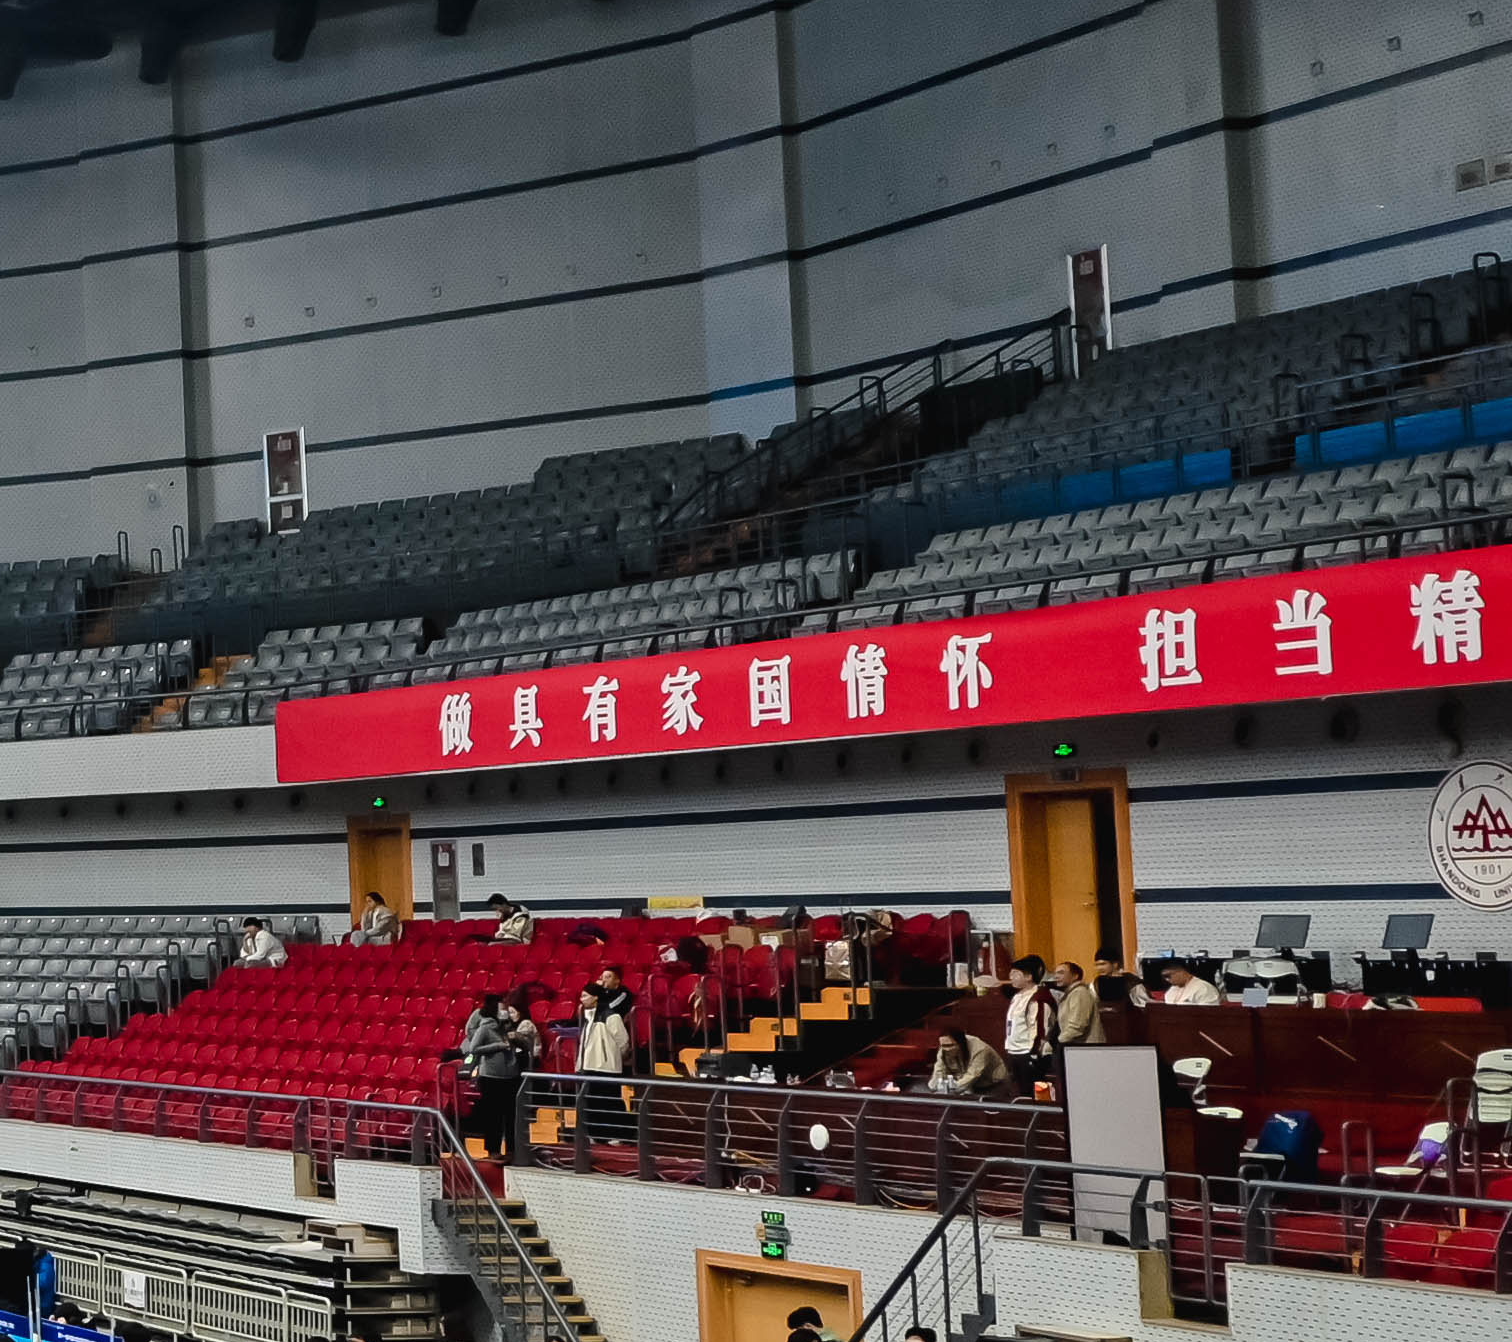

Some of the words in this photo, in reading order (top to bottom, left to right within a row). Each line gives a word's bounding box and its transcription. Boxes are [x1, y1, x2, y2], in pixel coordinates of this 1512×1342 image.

[438, 631, 994, 759] 做具有家国情怀
[1139, 569, 1487, 693] 担当精
[1473, 863, 1504, 876] 1901
